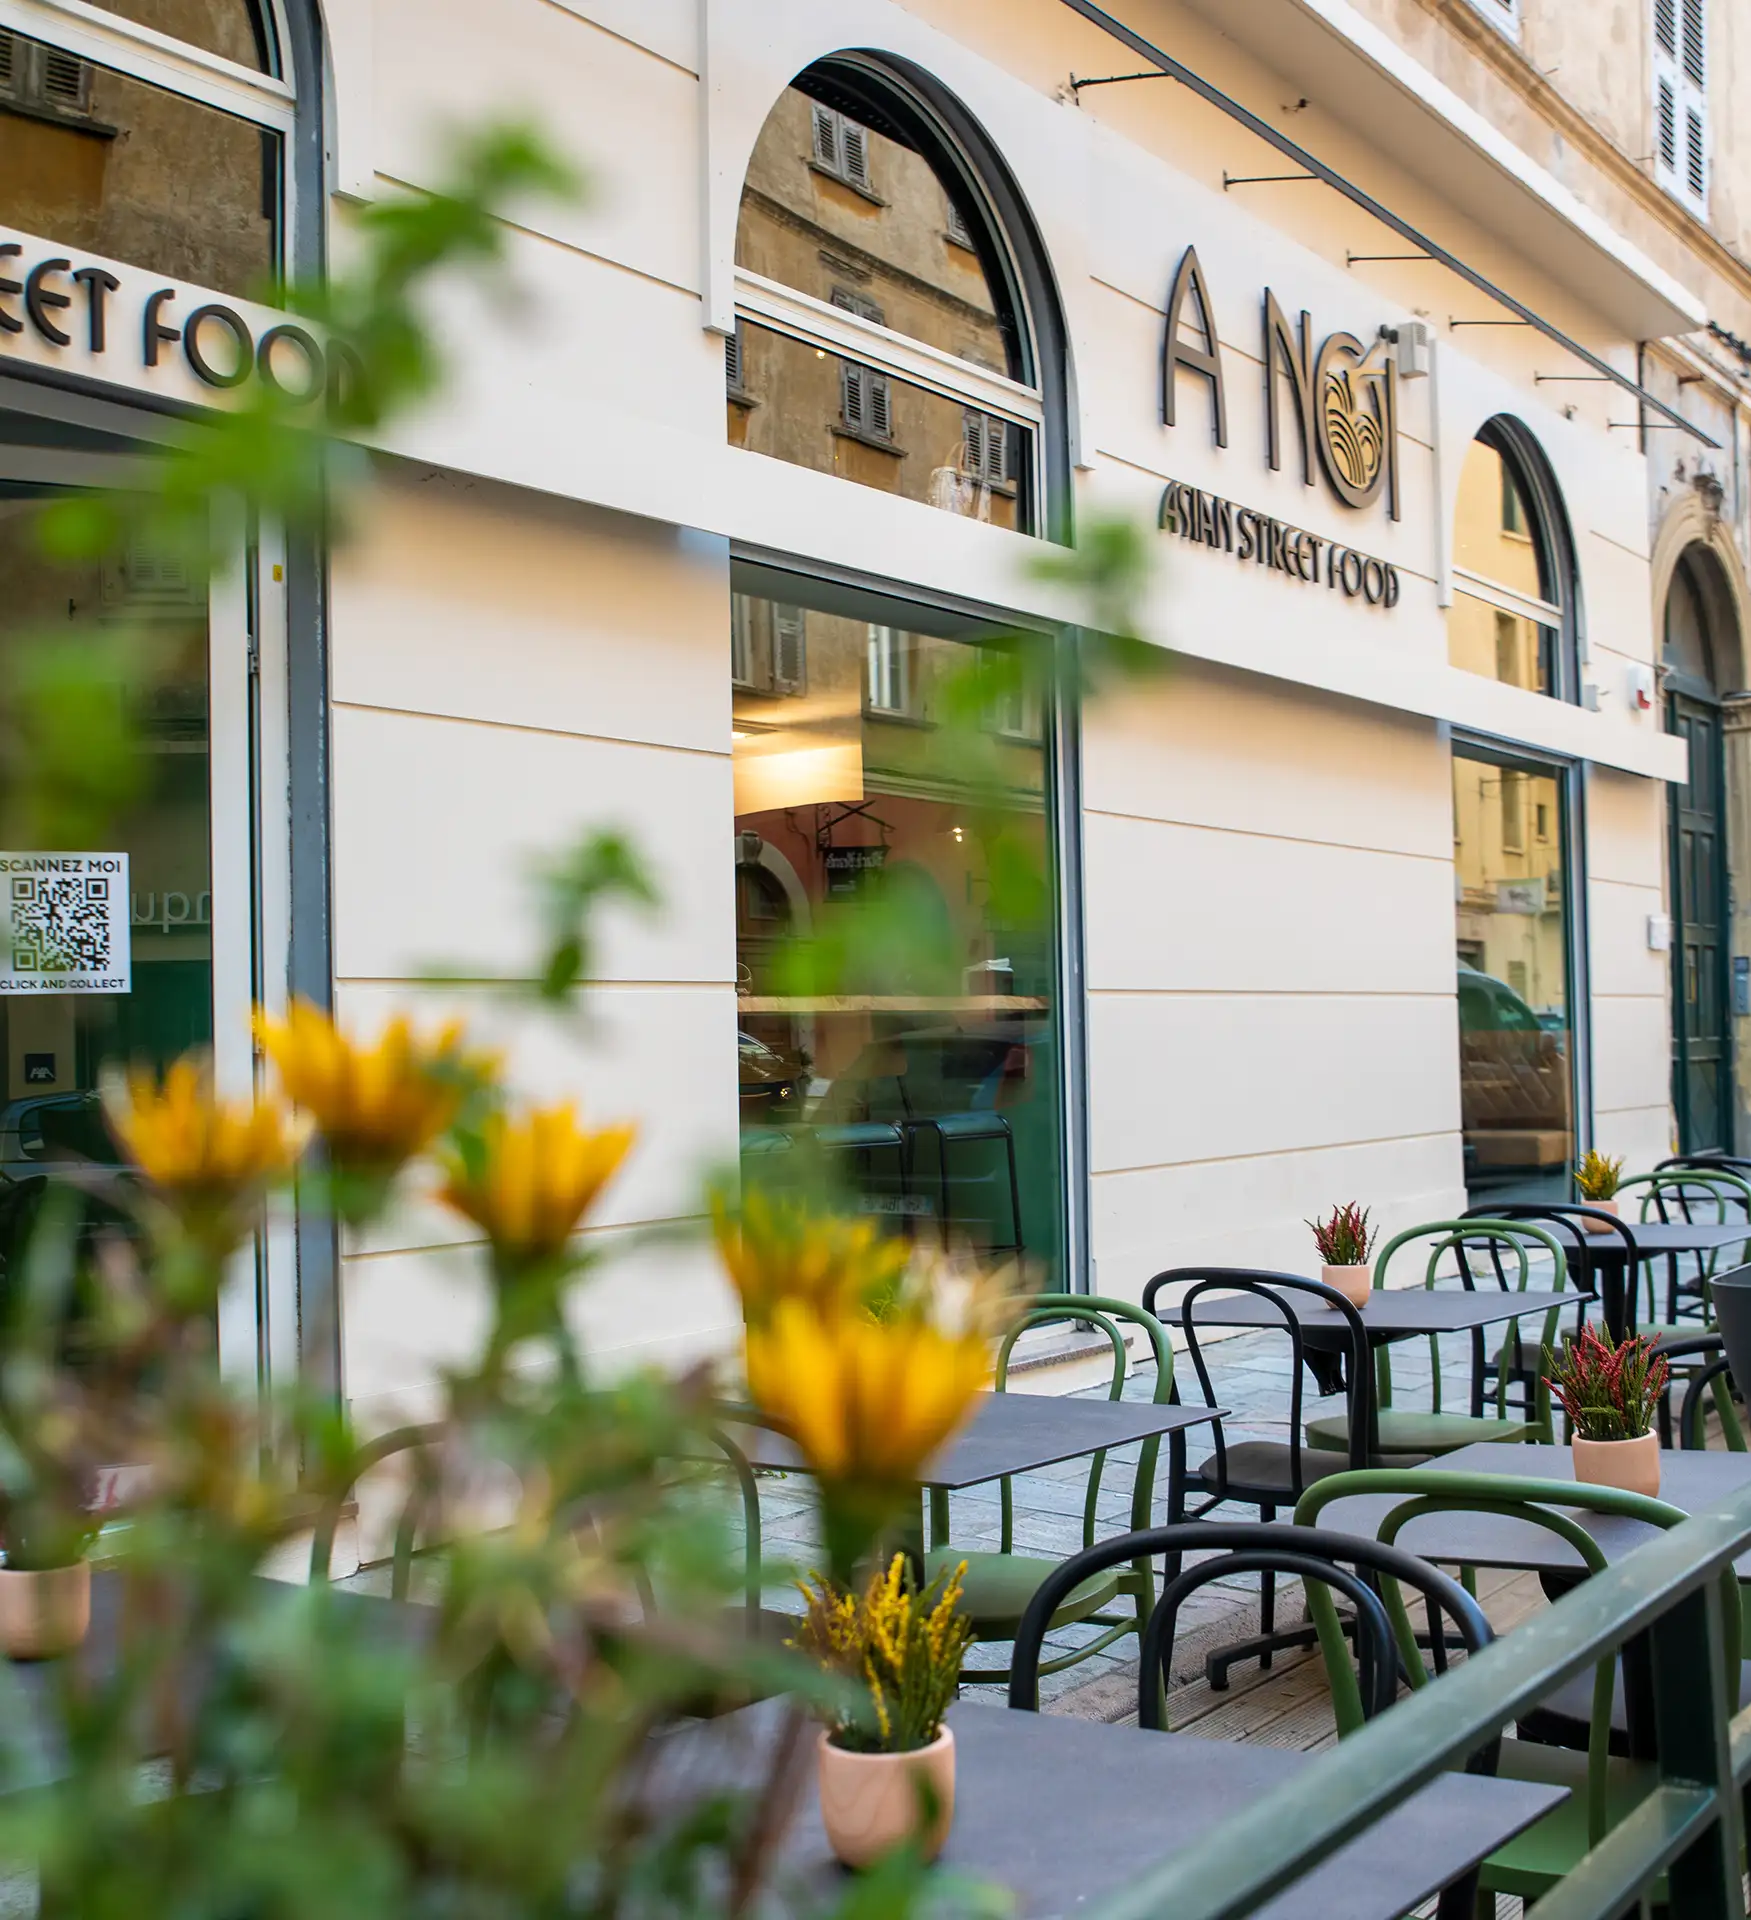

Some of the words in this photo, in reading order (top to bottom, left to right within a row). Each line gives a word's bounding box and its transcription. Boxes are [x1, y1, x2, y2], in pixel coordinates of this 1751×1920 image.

[1162, 244, 1228, 449] A
[1158, 480, 1234, 553] ASIAN
[1237, 508, 1323, 583] STREET
[1328, 543, 1400, 608] FOOD
[0, 859, 83, 873] SCANNEZ
[88, 860, 121, 873] MOI
[0, 980, 38, 990] CLICK
[41, 979, 67, 990] AND
[68, 978, 126, 989] COLLECT
